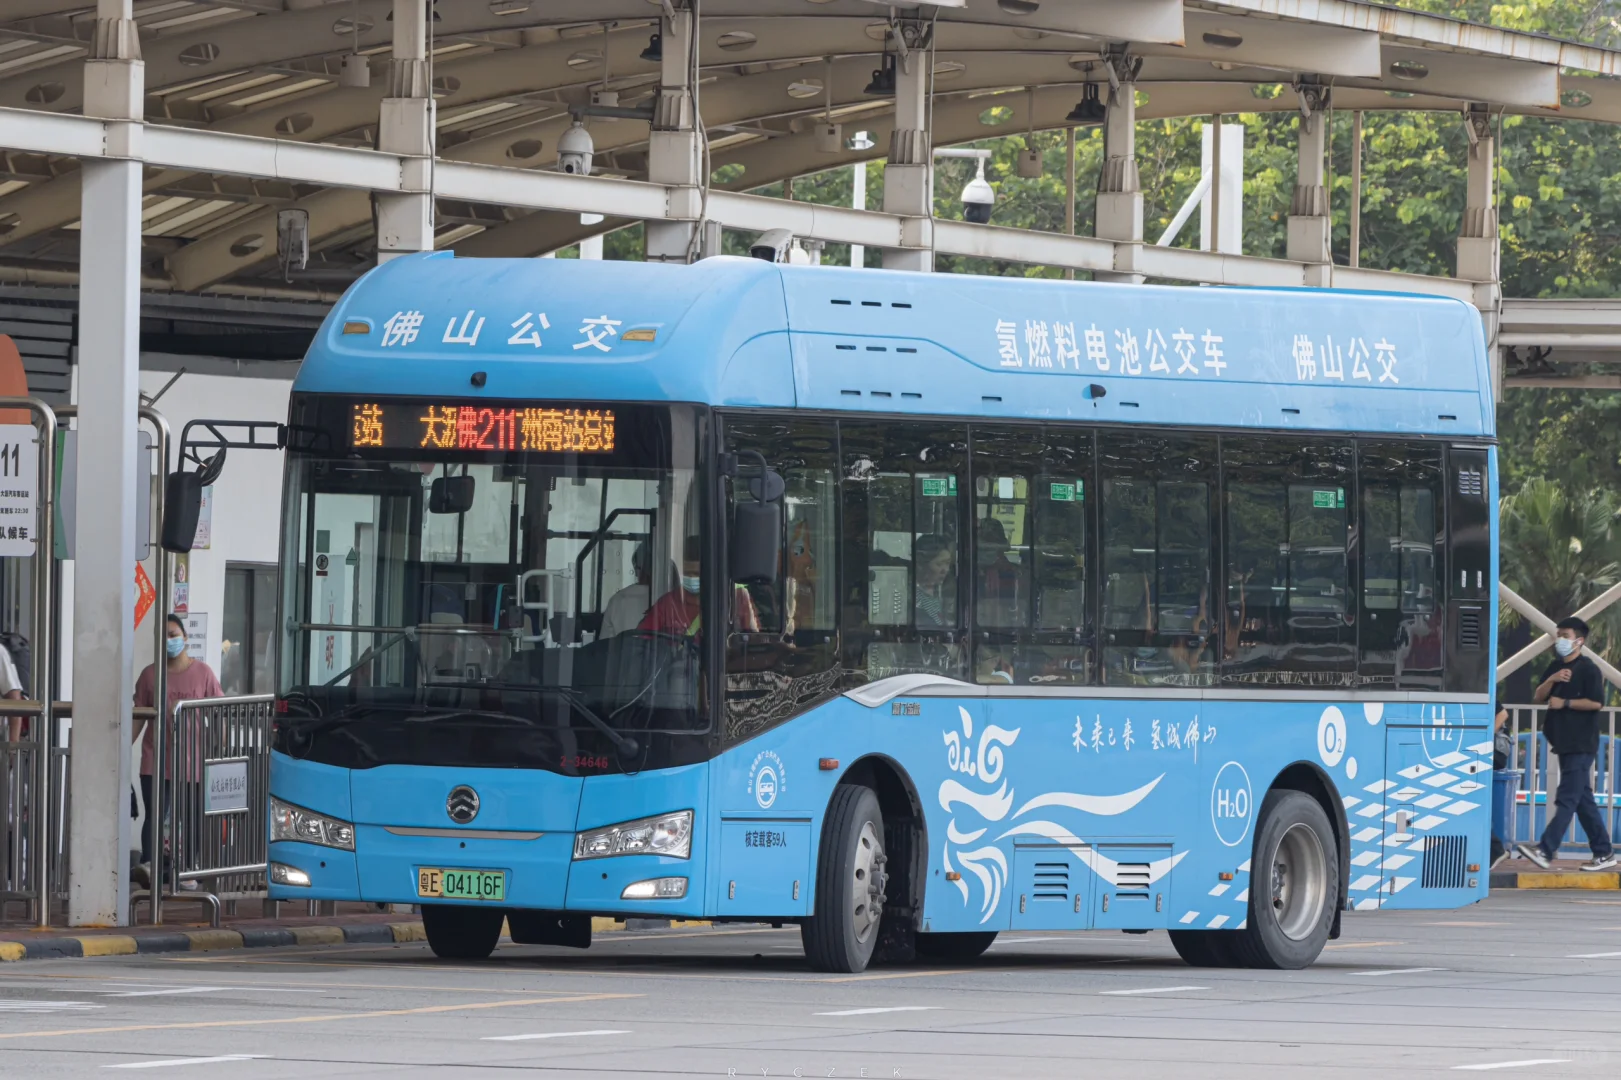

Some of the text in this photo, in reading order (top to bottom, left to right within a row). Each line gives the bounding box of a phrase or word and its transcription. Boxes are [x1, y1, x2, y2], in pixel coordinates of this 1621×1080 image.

[381, 309, 623, 353] 佛山公交
[994, 318, 1228, 376] 氢燃料电池公交车
[1291, 334, 1400, 385] 佛山公交
[1072, 713, 1136, 754] 未来已来
[560, 755, 609, 769] 2-34646
[745, 830, 787, 848] 核定载客59人
